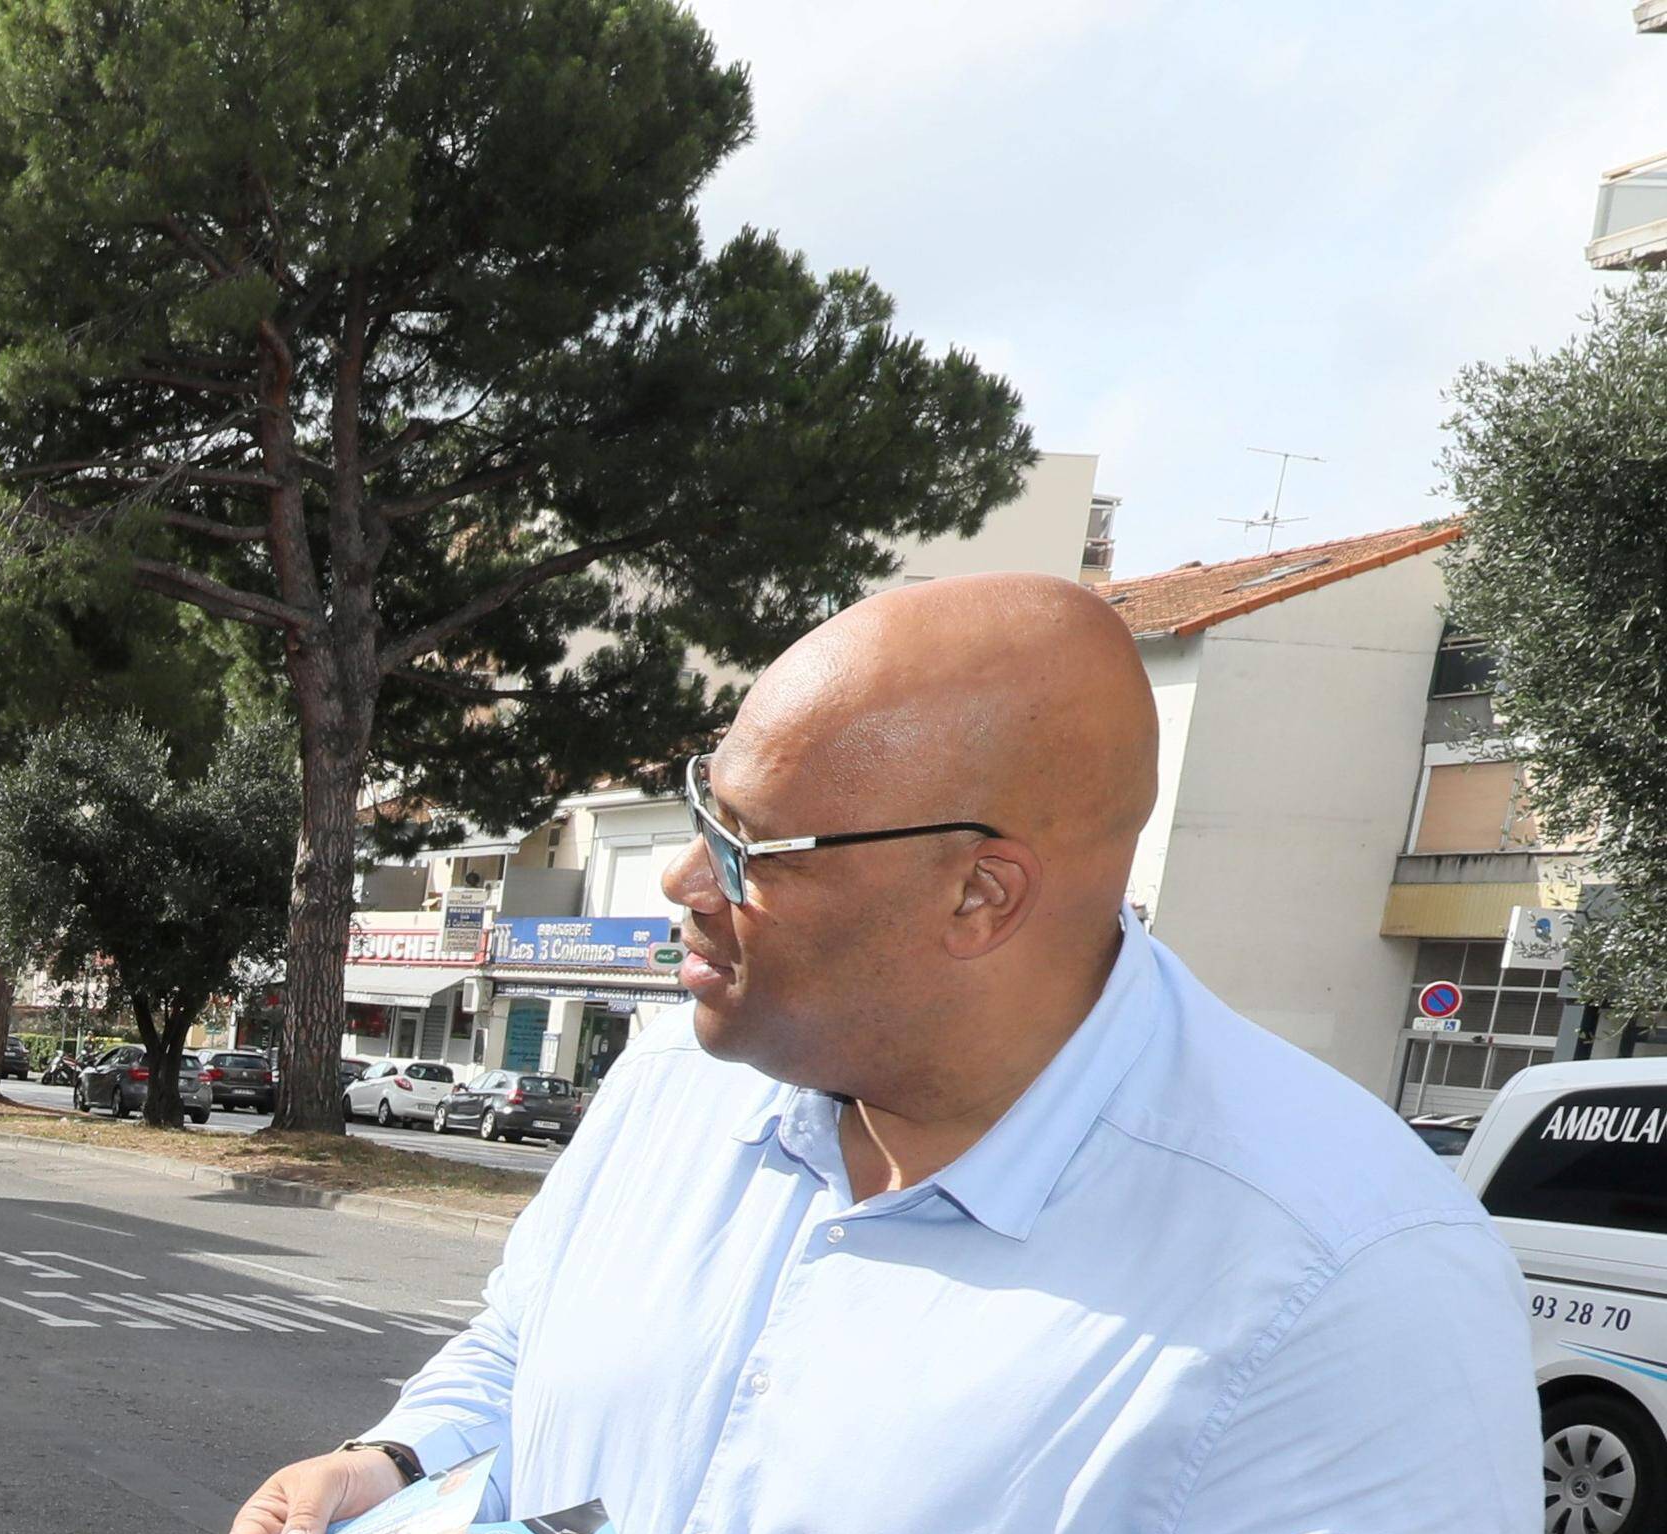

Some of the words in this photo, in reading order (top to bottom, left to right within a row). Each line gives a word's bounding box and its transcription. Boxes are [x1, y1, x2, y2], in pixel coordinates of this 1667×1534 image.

[349, 934, 476, 959] BOUCHE
[509, 938, 535, 960] Les
[539, 939, 550, 960] 3
[552, 938, 616, 963] Colonnes
[1531, 1295, 1557, 1319] 93
[1565, 1300, 1593, 1325] 28
[1602, 1306, 1631, 1331] 70
